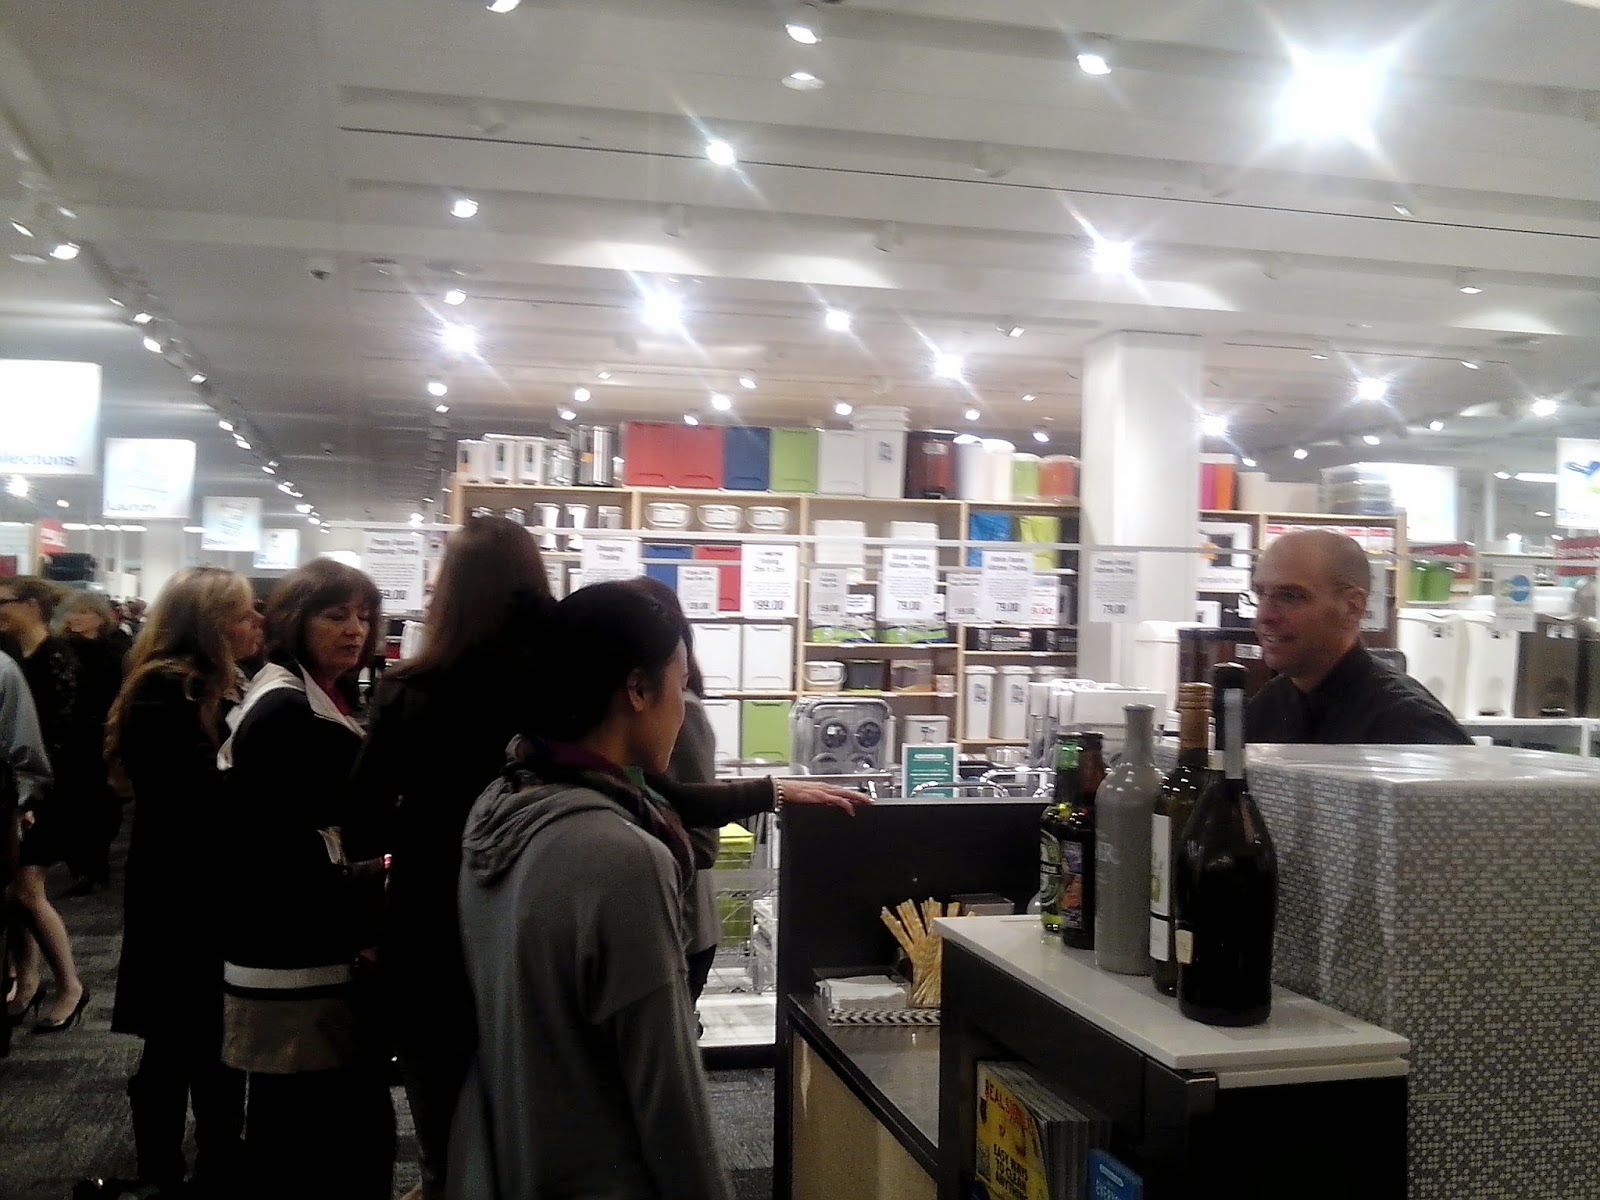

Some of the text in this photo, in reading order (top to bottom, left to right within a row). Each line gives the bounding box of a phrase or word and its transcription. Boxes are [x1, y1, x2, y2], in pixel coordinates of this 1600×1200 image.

[753, 600, 784, 611] 199.00
[896, 600, 921, 611] 79.00
[995, 602, 1020, 612] 79.00
[1102, 604, 1127, 614] 79.00
[994, 1144, 1009, 1165] EASY
